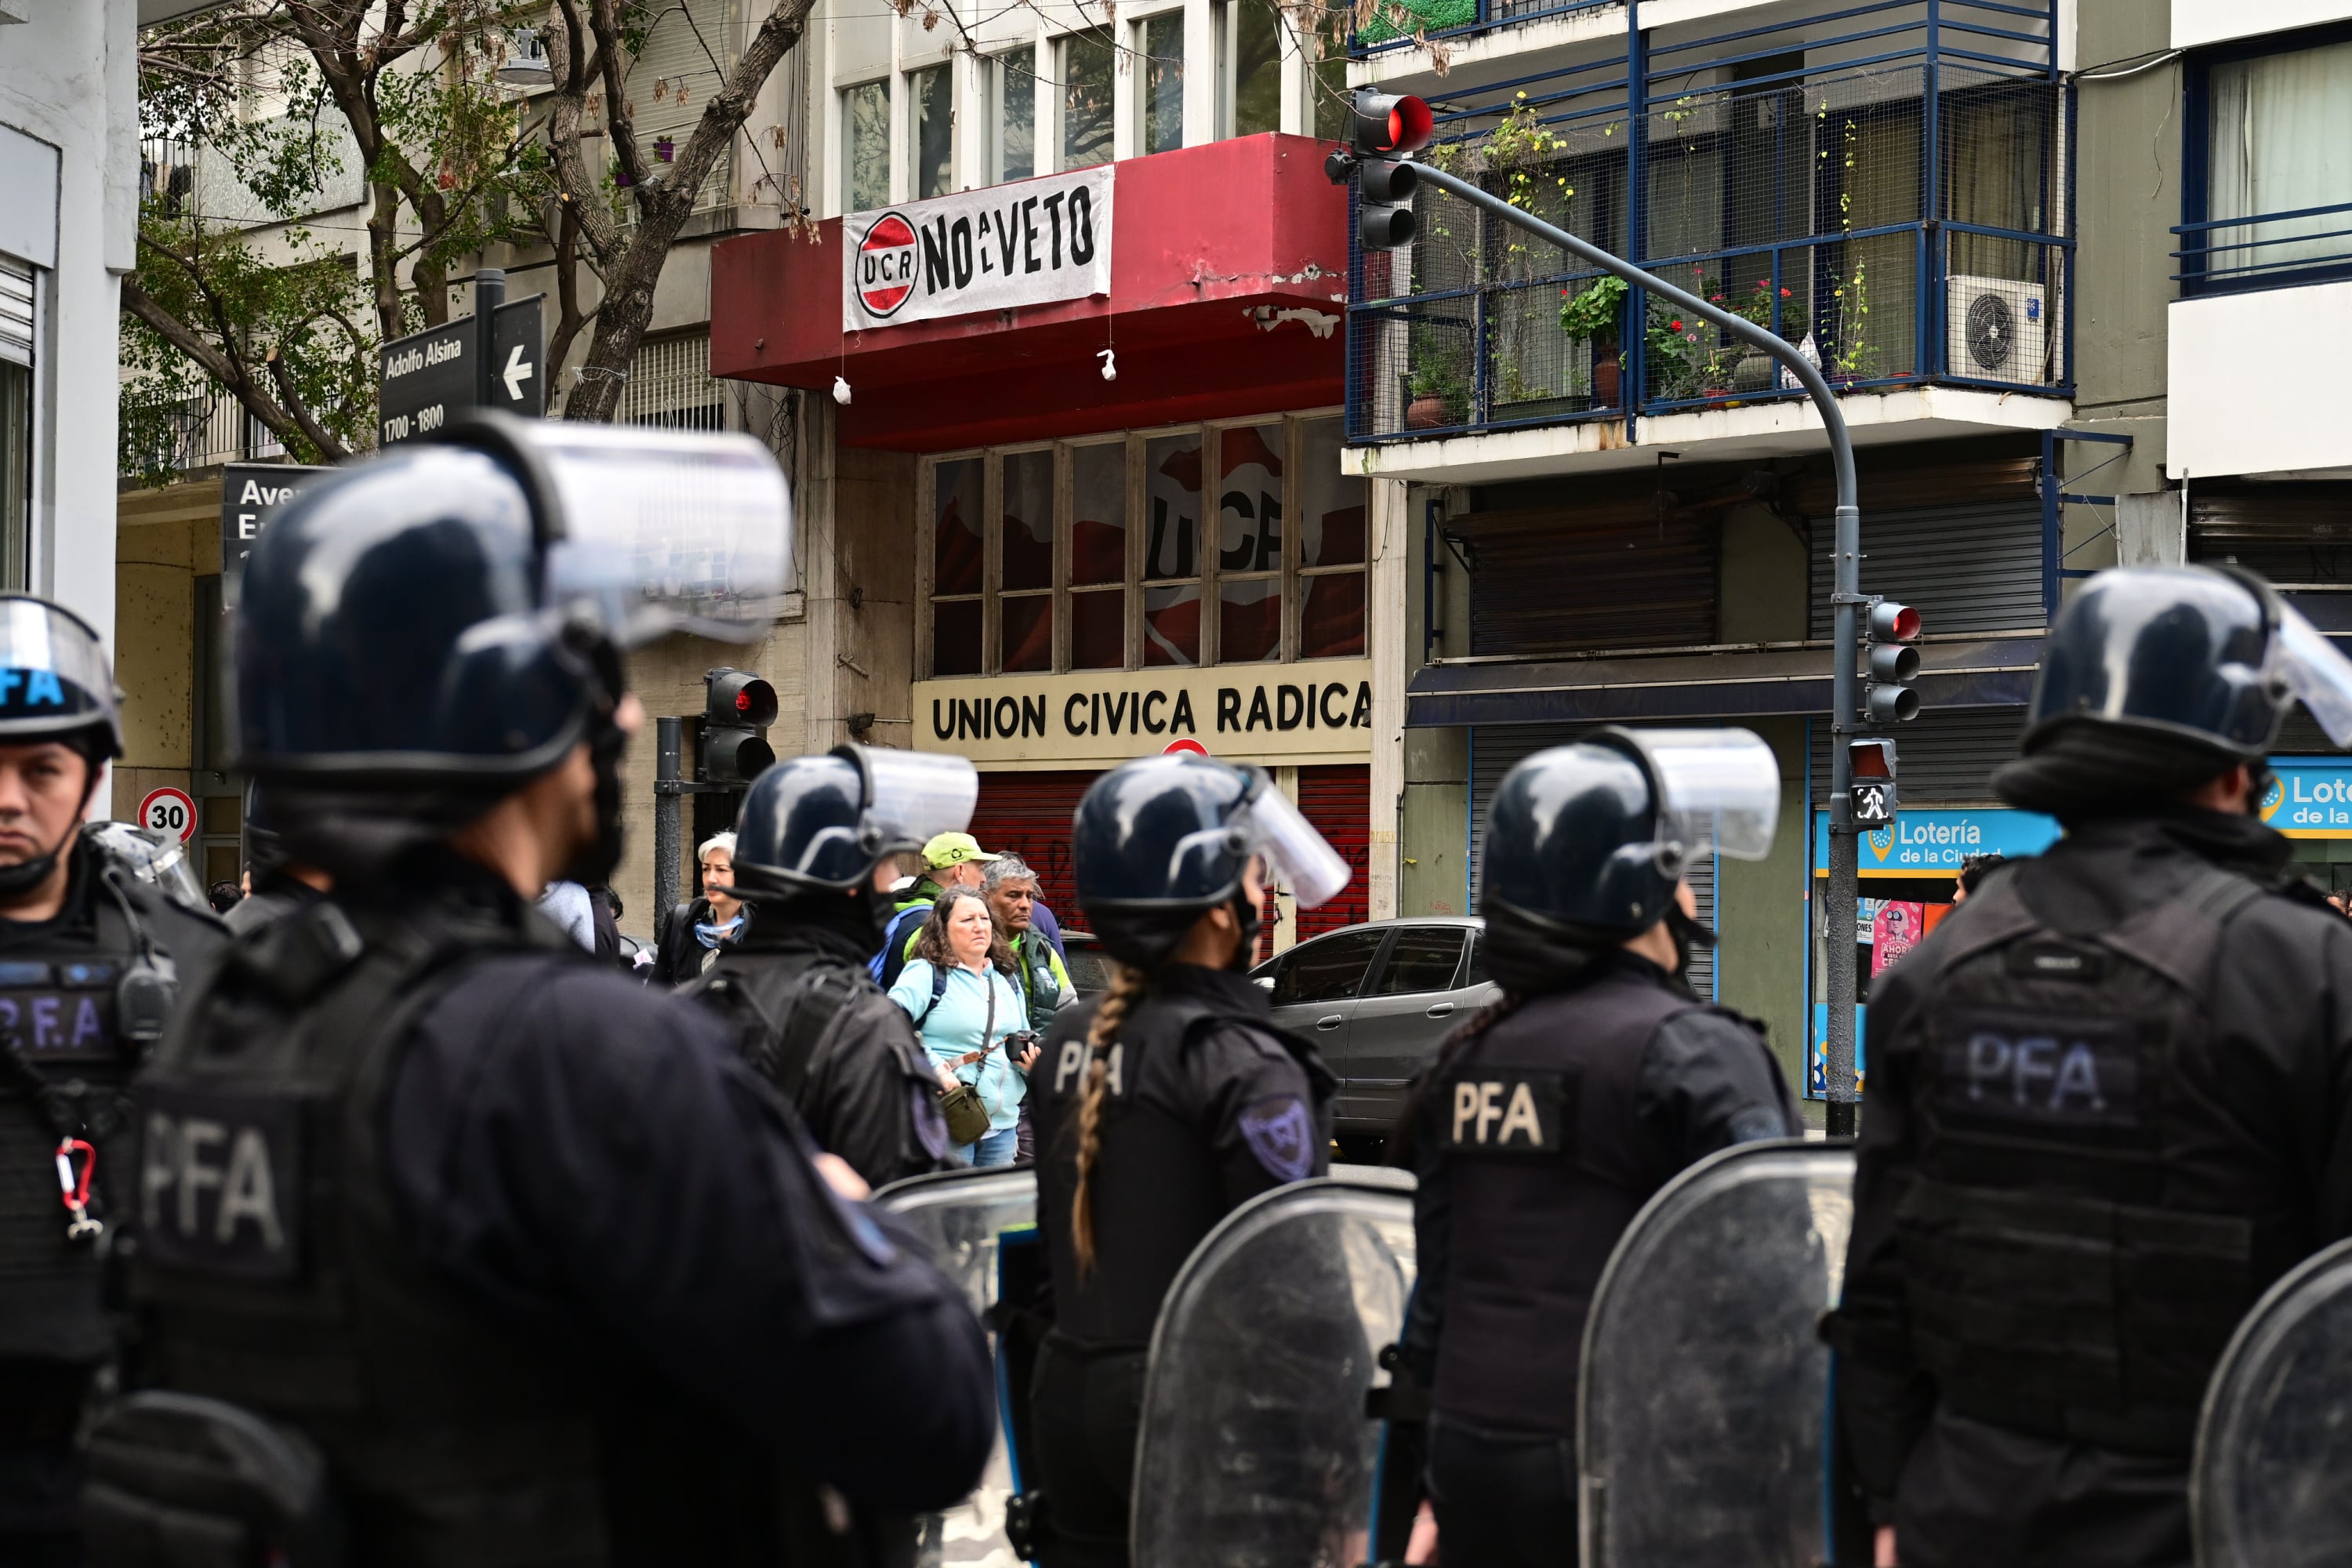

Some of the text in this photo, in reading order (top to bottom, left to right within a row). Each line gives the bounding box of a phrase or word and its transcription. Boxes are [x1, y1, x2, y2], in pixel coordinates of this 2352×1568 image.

[920, 214, 974, 296] NO
[994, 185, 1094, 277] VETO
[865, 250, 912, 285] UCR
[386, 338, 462, 380] Adolfo Alsina
[384, 415, 408, 442] 1700
[417, 404, 444, 433] 1800
[933, 694, 1046, 739] UNION
[1064, 689, 1196, 735] CIVICA
[151, 804, 185, 831] 30
[1900, 819, 1981, 845] Lotería
[2292, 808, 2350, 824] de la
[1900, 848, 1921, 863] de
[1925, 848, 1939, 863] la
[1967, 1033, 2107, 1112] PFA
[1453, 1082, 1544, 1147] PFA
[140, 1112, 284, 1251] PFA
